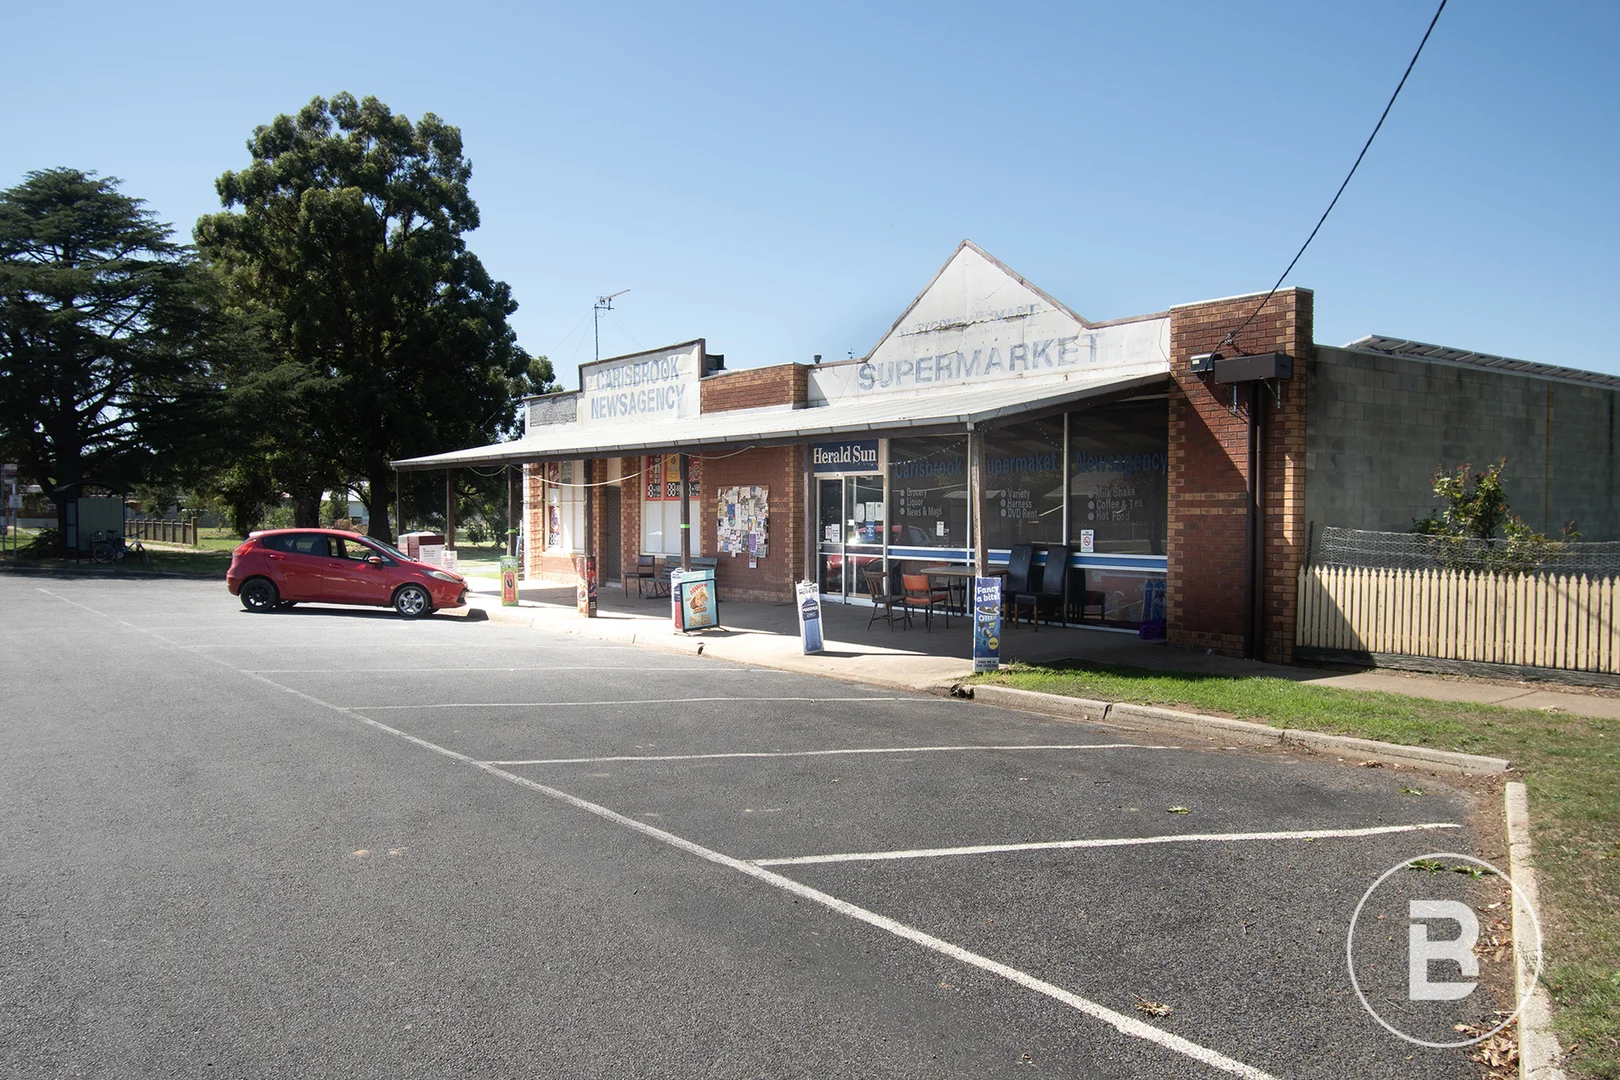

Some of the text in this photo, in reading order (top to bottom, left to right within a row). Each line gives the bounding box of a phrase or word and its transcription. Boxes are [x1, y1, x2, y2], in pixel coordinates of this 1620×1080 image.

[858, 333, 1105, 391] SUPERMARKET
[596, 356, 680, 391] CARISBROOK
[591, 384, 685, 419] NEWSAGENCY
[813, 445, 877, 464] Herald Sun
[895, 451, 1167, 478] Carisbrook upermaket Newsagency
[906, 487, 927, 499] Grocery
[1007, 488, 1031, 501] Variety
[1113, 486, 1136, 498] Shake
[906, 497, 923, 508] Liquor
[1007, 498, 1033, 509] Harness
[1096, 498, 1143, 511] Coffee & Tea
[906, 506, 943, 518] News & Mags
[1007, 508, 1038, 519] DVD Rent
[1096, 510, 1131, 521] Hot Food
[977, 585, 999, 594] Fancy
